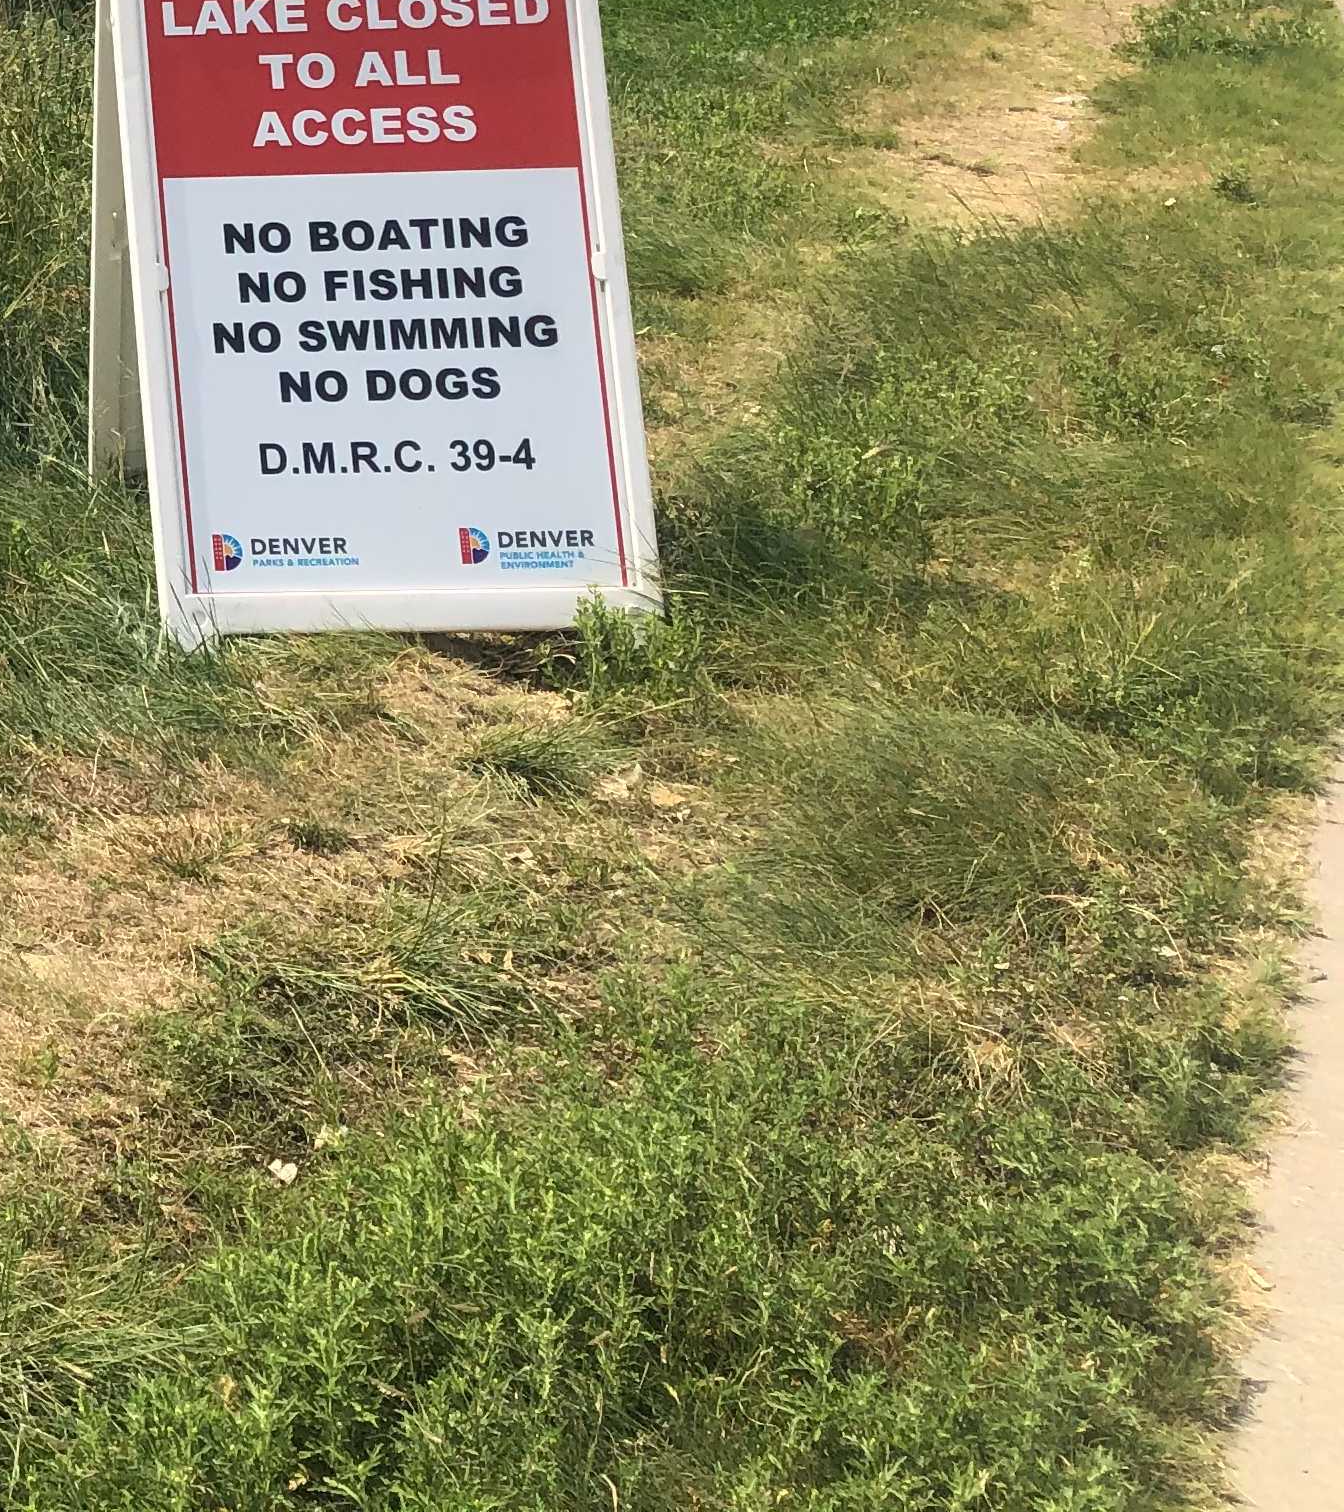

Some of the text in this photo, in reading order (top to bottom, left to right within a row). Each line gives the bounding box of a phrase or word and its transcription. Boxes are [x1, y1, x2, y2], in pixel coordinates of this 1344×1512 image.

[259, 50, 460, 89] TO ALL
[253, 106, 476, 146] ACCESS
[223, 216, 528, 254] NO BOATING
[238, 266, 522, 303] NO FISHING
[213, 315, 558, 353] NO SWIMMING
[279, 367, 500, 402] NO DOGS
[259, 438, 535, 474] D.M.R.C. 39-4
[251, 538, 347, 555] DENVER
[497, 530, 594, 548] DENVER
[499, 551, 534, 560] PUBLIC
[536, 551, 575, 560] HEALTH
[253, 558, 284, 567] PARKS
[297, 557, 359, 567] RECREATION
[500, 560, 574, 570] ENVIRONMENT
